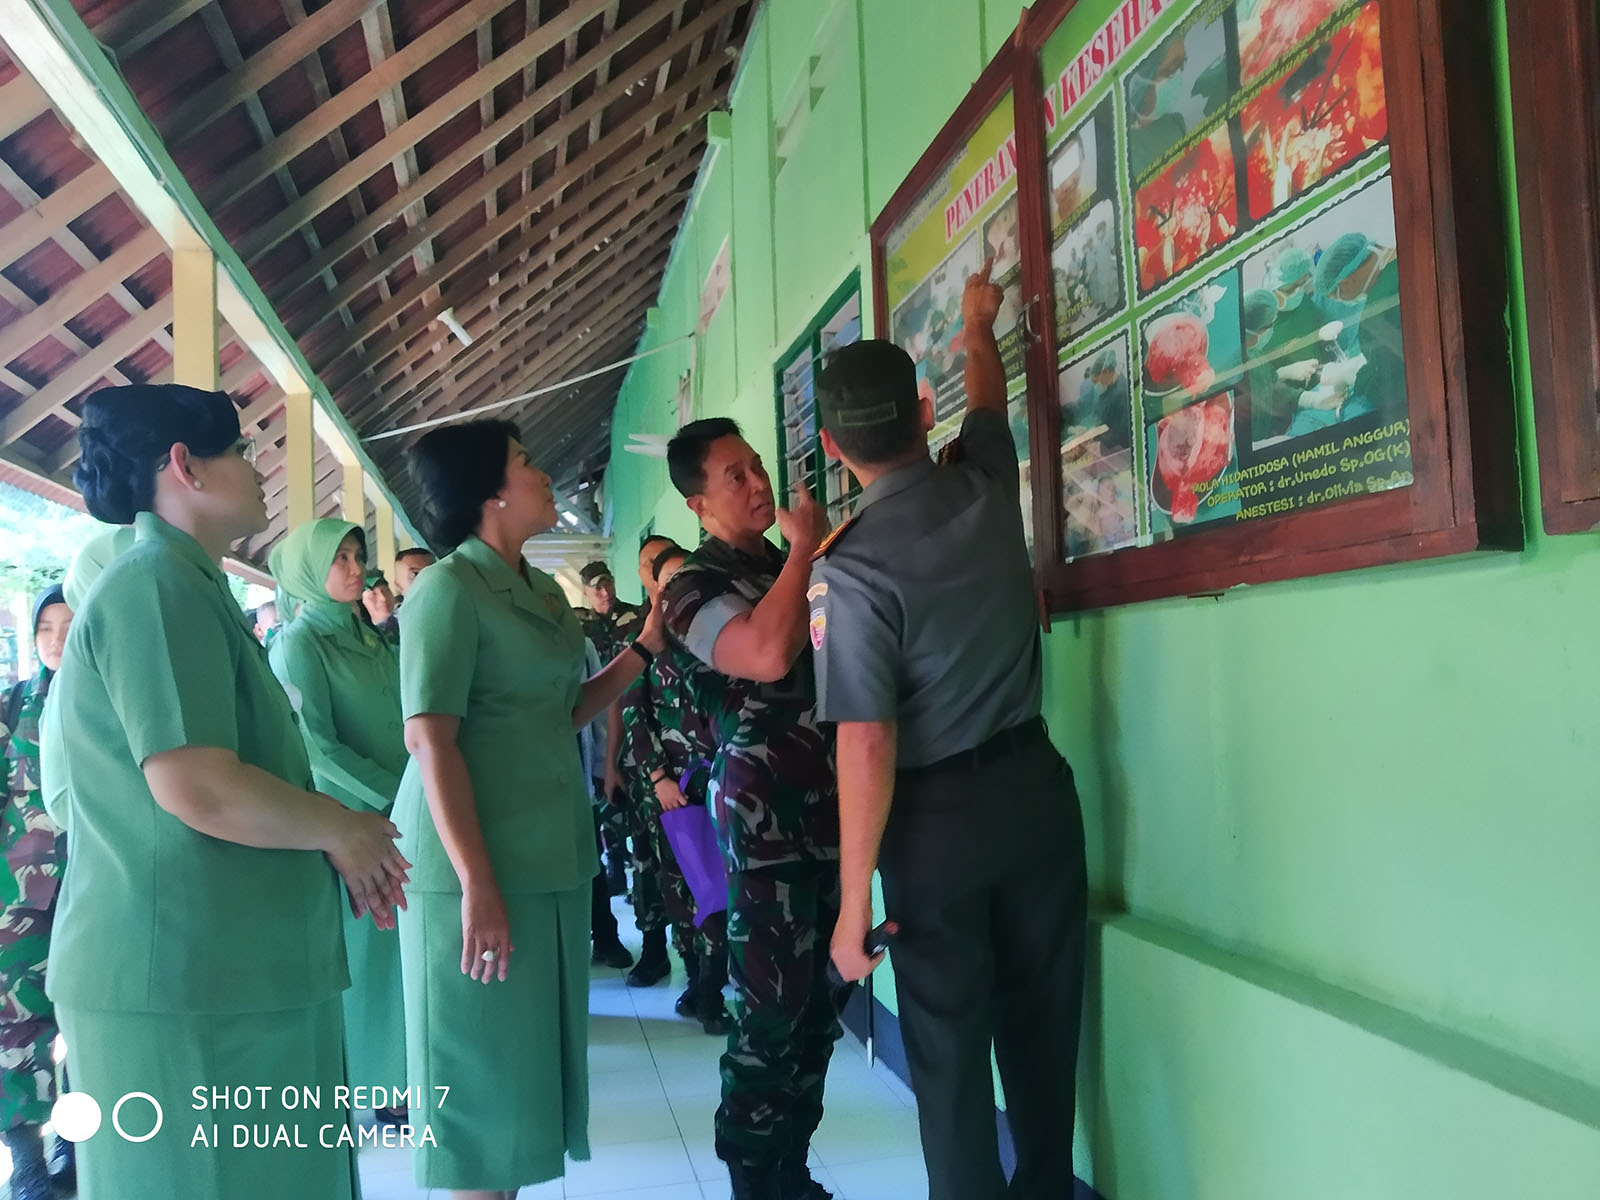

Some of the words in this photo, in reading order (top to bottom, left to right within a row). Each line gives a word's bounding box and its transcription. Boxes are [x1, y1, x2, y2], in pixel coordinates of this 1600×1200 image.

[1060, 0, 1172, 116] KESEHA
[1191, 479, 1218, 495] MOLA
[1220, 457, 1290, 485] HIDATIDOSA
[1292, 445, 1340, 469] (HAMIL
[1342, 418, 1411, 451] ANGGUR)
[1207, 481, 1267, 508] OPERATOR
[1277, 463, 1337, 490] dr.Unedo
[1340, 440, 1411, 474] Sp.OG(K)
[1235, 497, 1295, 521] ANESTESI
